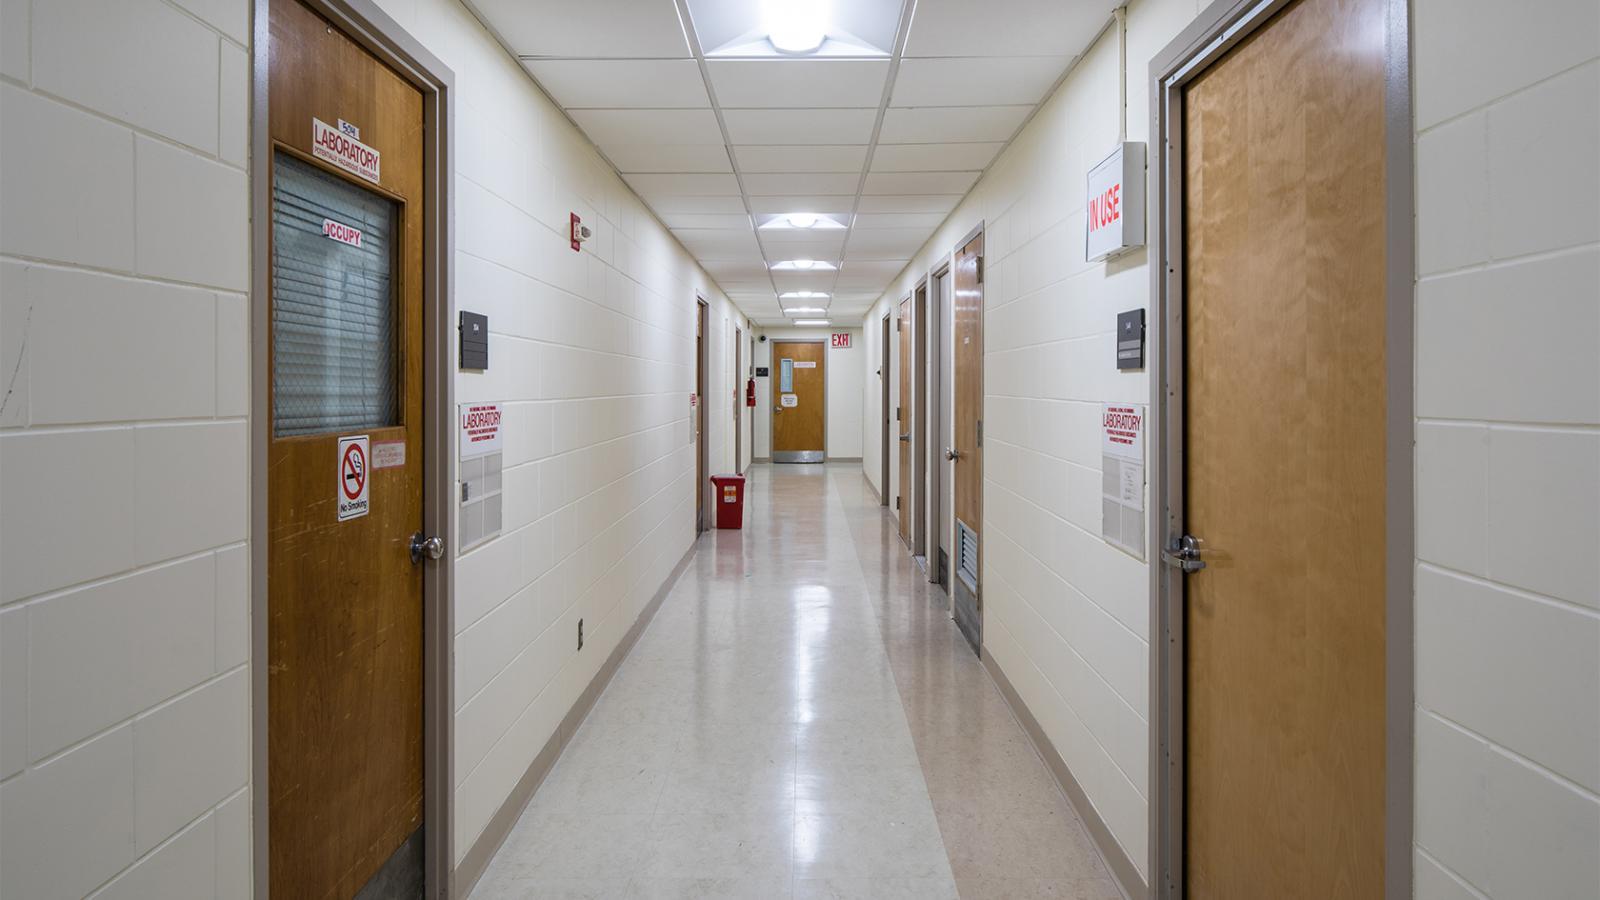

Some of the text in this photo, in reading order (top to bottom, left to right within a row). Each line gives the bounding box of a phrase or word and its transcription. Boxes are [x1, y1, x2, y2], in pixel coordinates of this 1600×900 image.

[315, 124, 378, 171] LABORATORY
[1090, 184, 1119, 232] IN USE
[831, 333, 849, 347] EXIT
[463, 411, 502, 429] LABORATORY
[1103, 413, 1141, 431] LABORATORY
[341, 500, 367, 512] No Smoking
